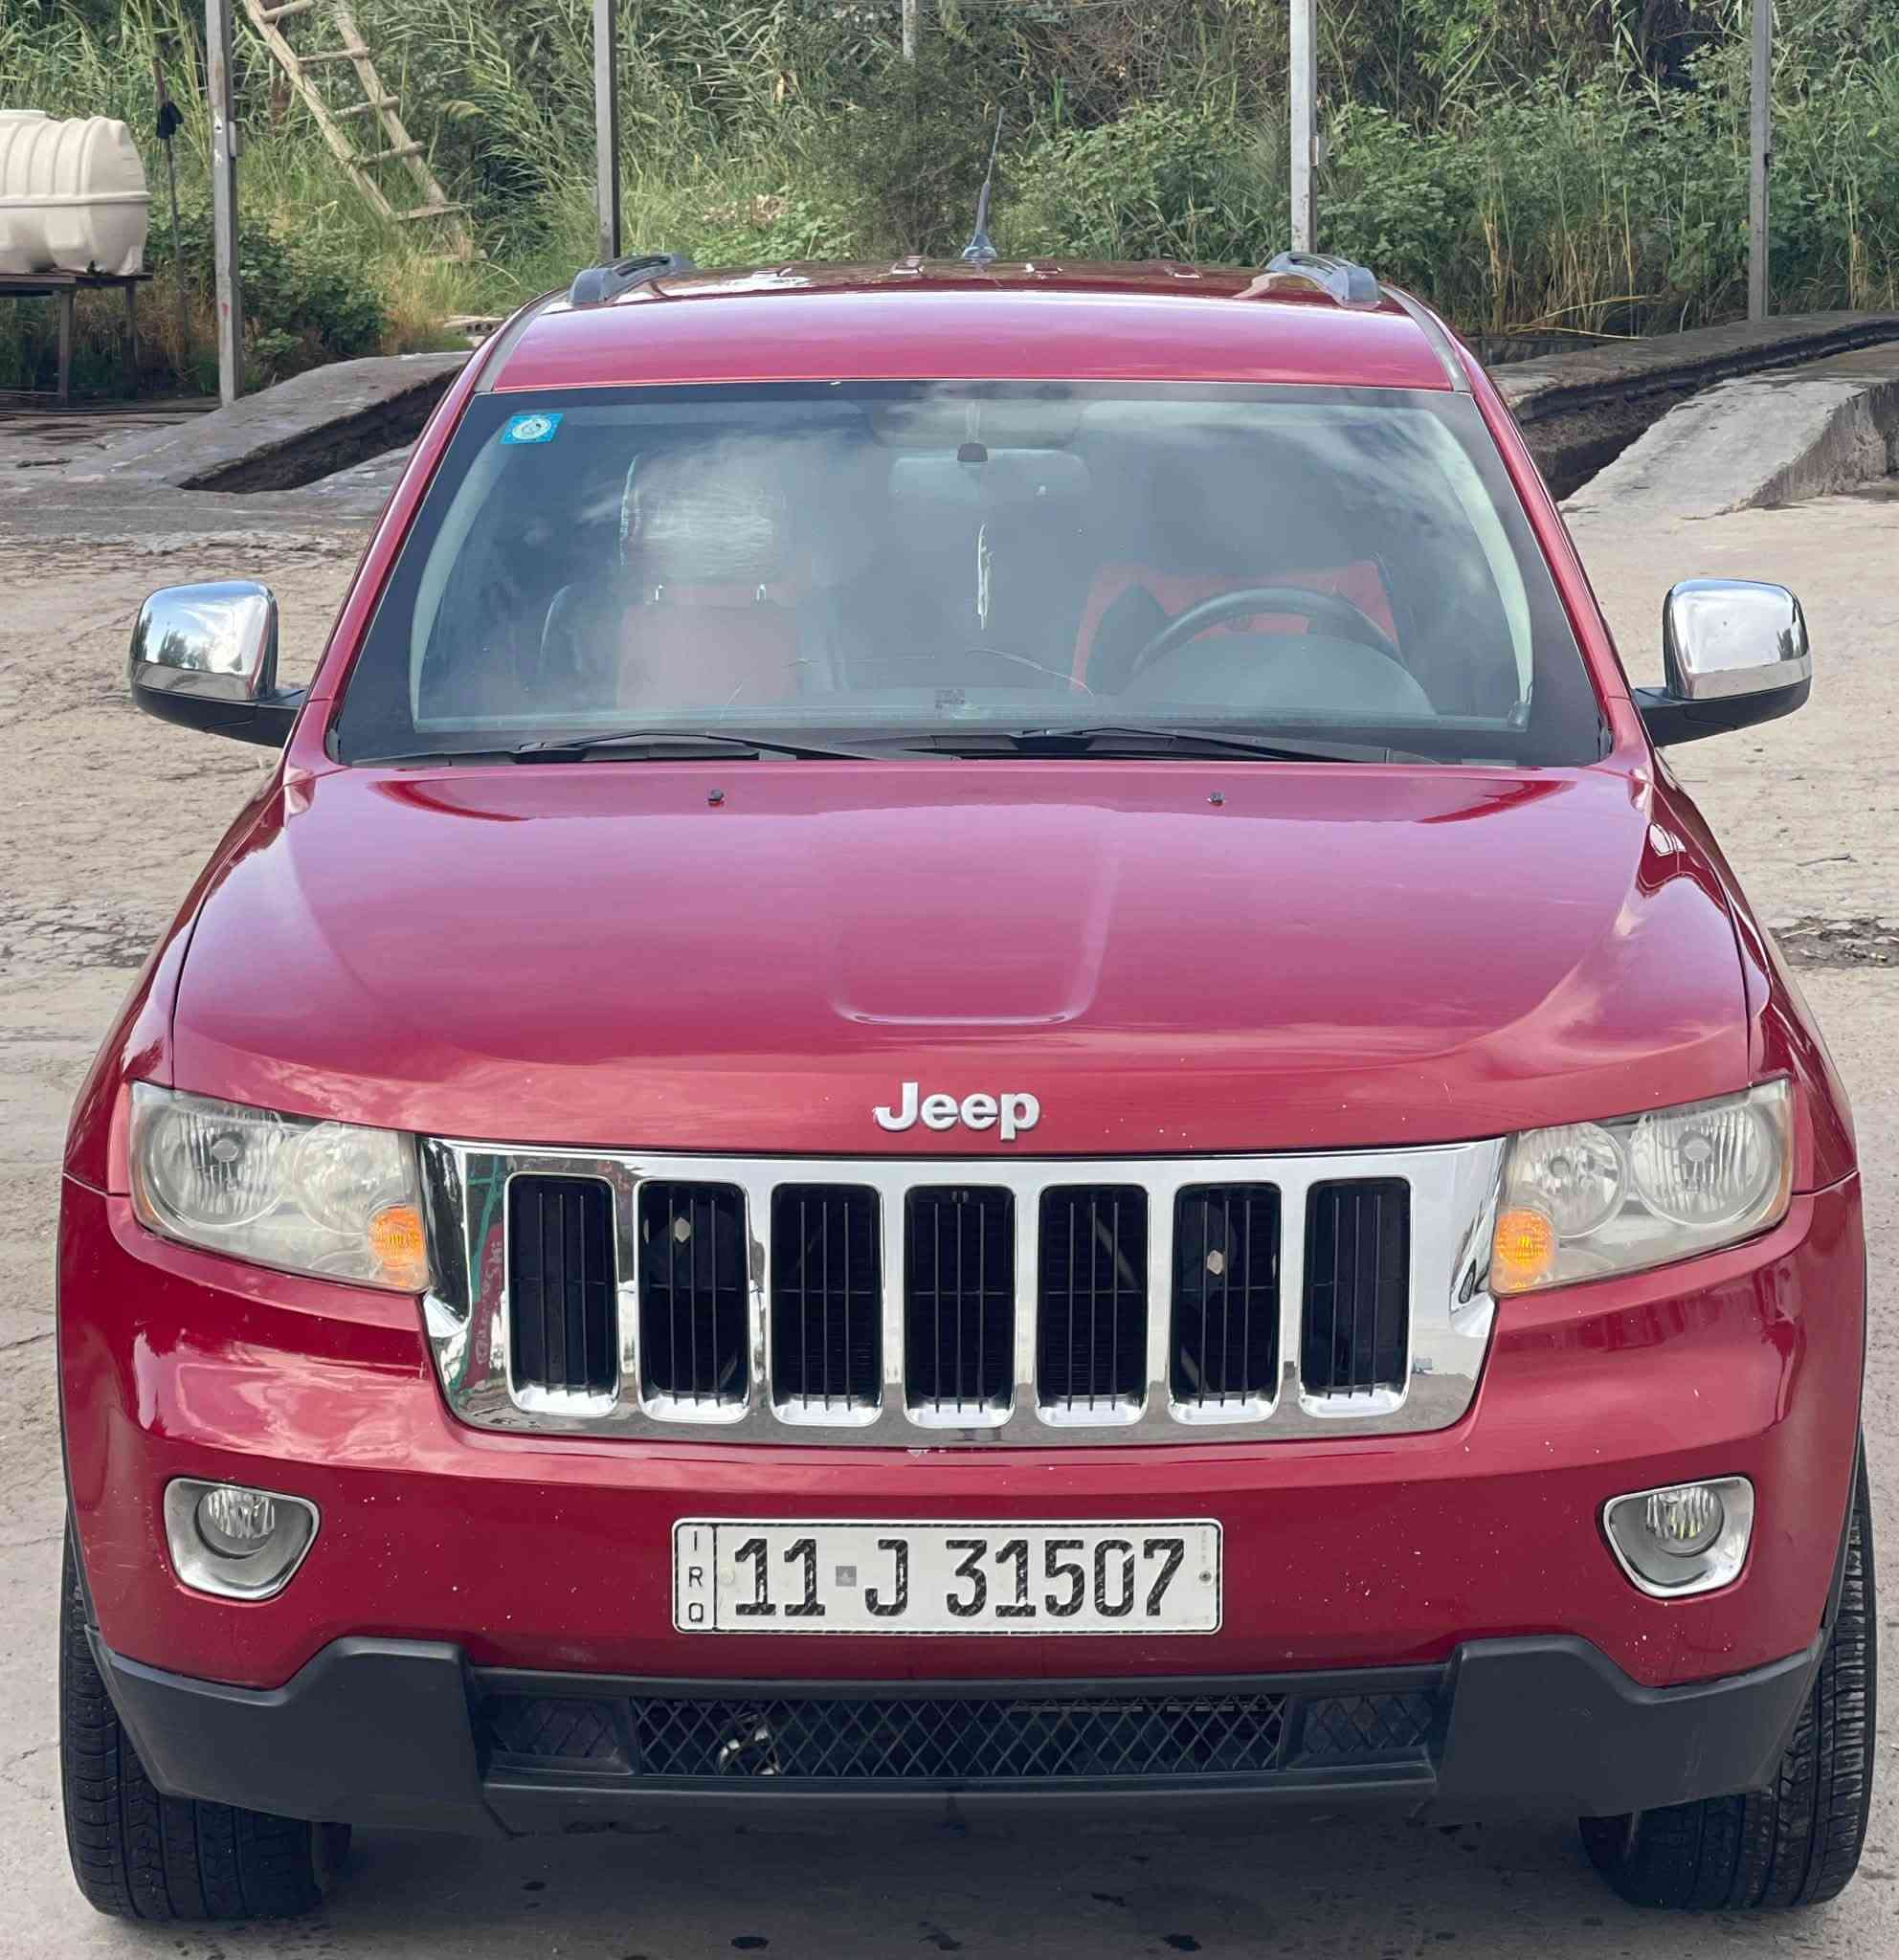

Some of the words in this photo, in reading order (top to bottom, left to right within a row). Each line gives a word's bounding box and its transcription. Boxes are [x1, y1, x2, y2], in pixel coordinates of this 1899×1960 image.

[873, 1081, 1039, 1140] Jeep
[734, 1538, 825, 1616] 11
[865, 1539, 908, 1616] J
[946, 1539, 1185, 1617] 31507
